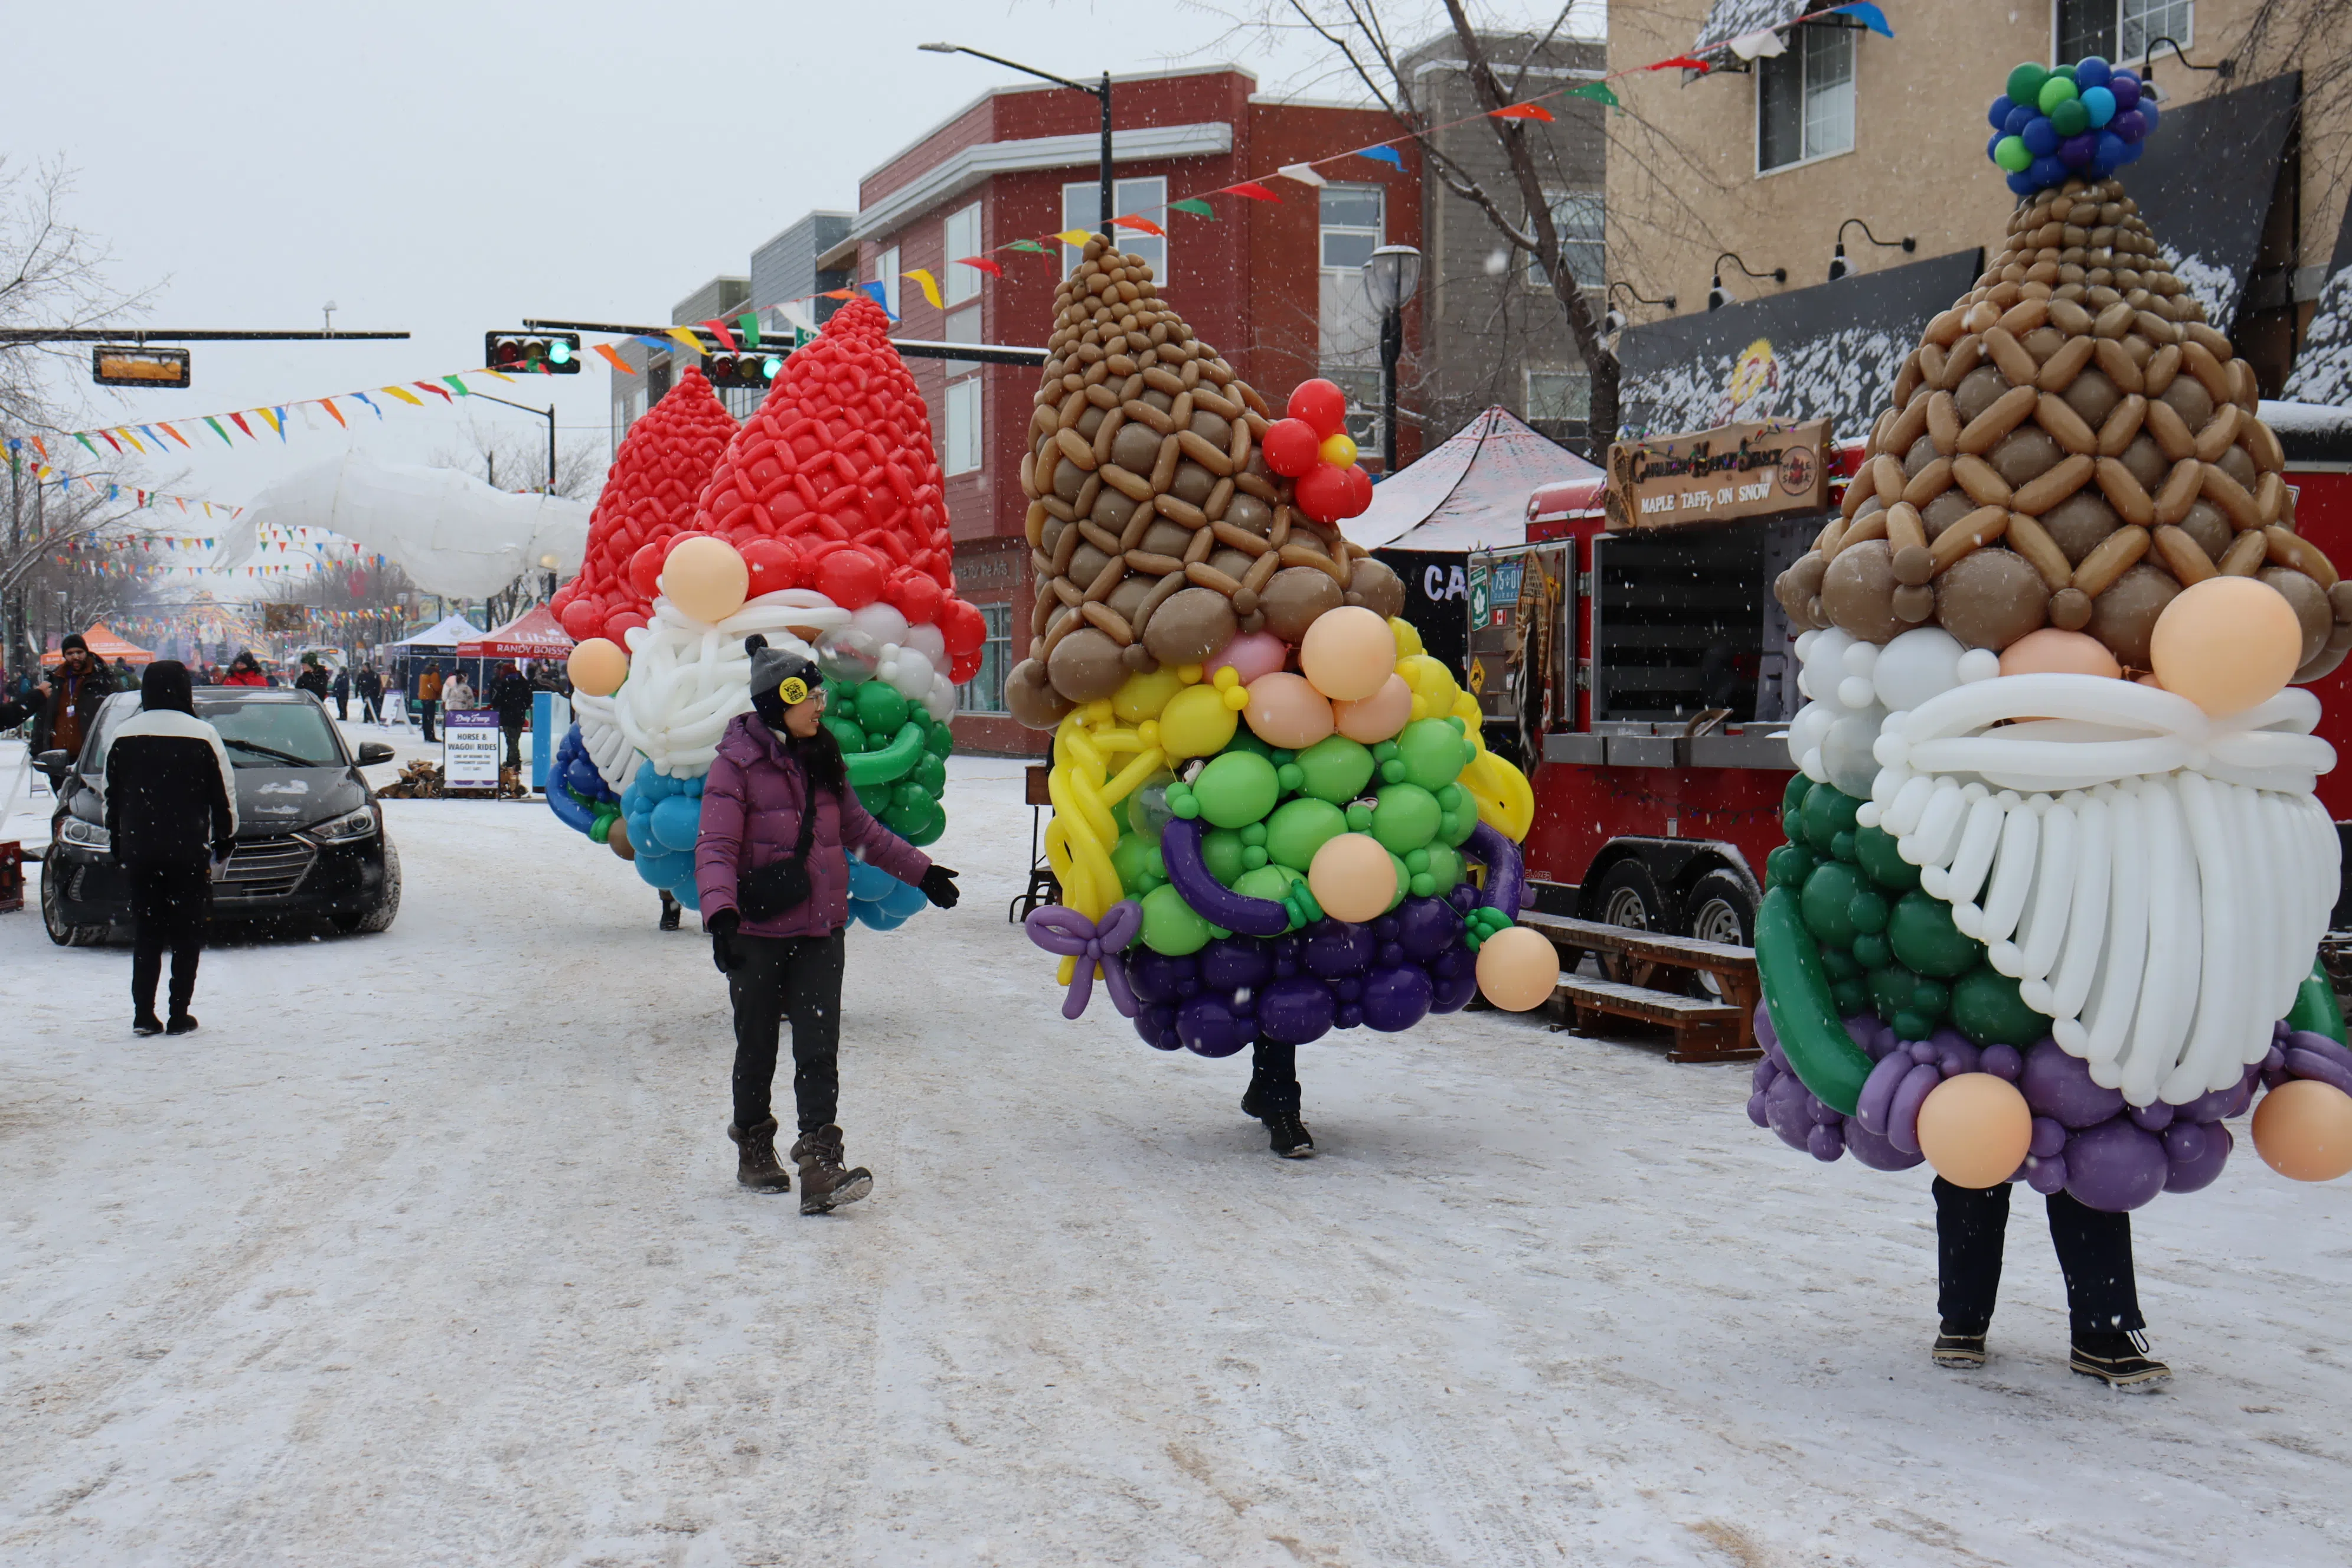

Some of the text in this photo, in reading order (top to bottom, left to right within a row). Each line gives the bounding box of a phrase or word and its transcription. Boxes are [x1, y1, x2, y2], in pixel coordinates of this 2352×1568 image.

[1641, 495, 1674, 514] MAPLE
[1717, 487, 1733, 505] ON
[1739, 483, 1771, 502] SNOW
[496, 644, 573, 656] RANDY BOISSO
[790, 692, 804, 702] EER
[1525, 869, 1551, 881] BLAZER
